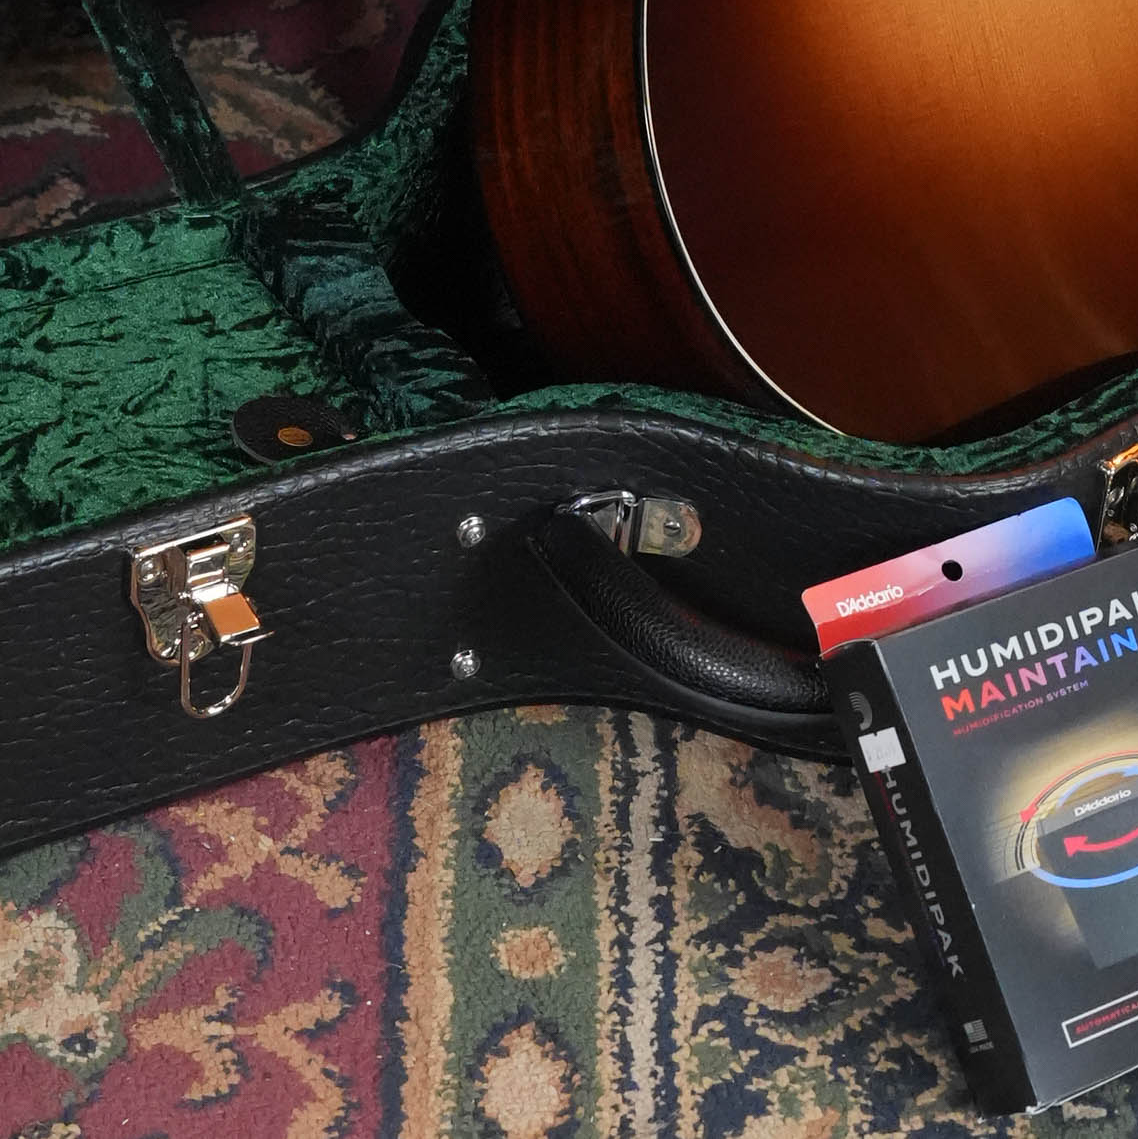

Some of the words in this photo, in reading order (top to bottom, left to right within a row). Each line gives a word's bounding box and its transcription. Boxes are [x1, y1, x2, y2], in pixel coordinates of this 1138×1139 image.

[836, 583, 904, 618] D'Addario
[953, 697, 1044, 736] HUMIDIFICATION
[1046, 680, 1089, 702] SYSTEM
[881, 766, 965, 981] HUMIDIPAK
